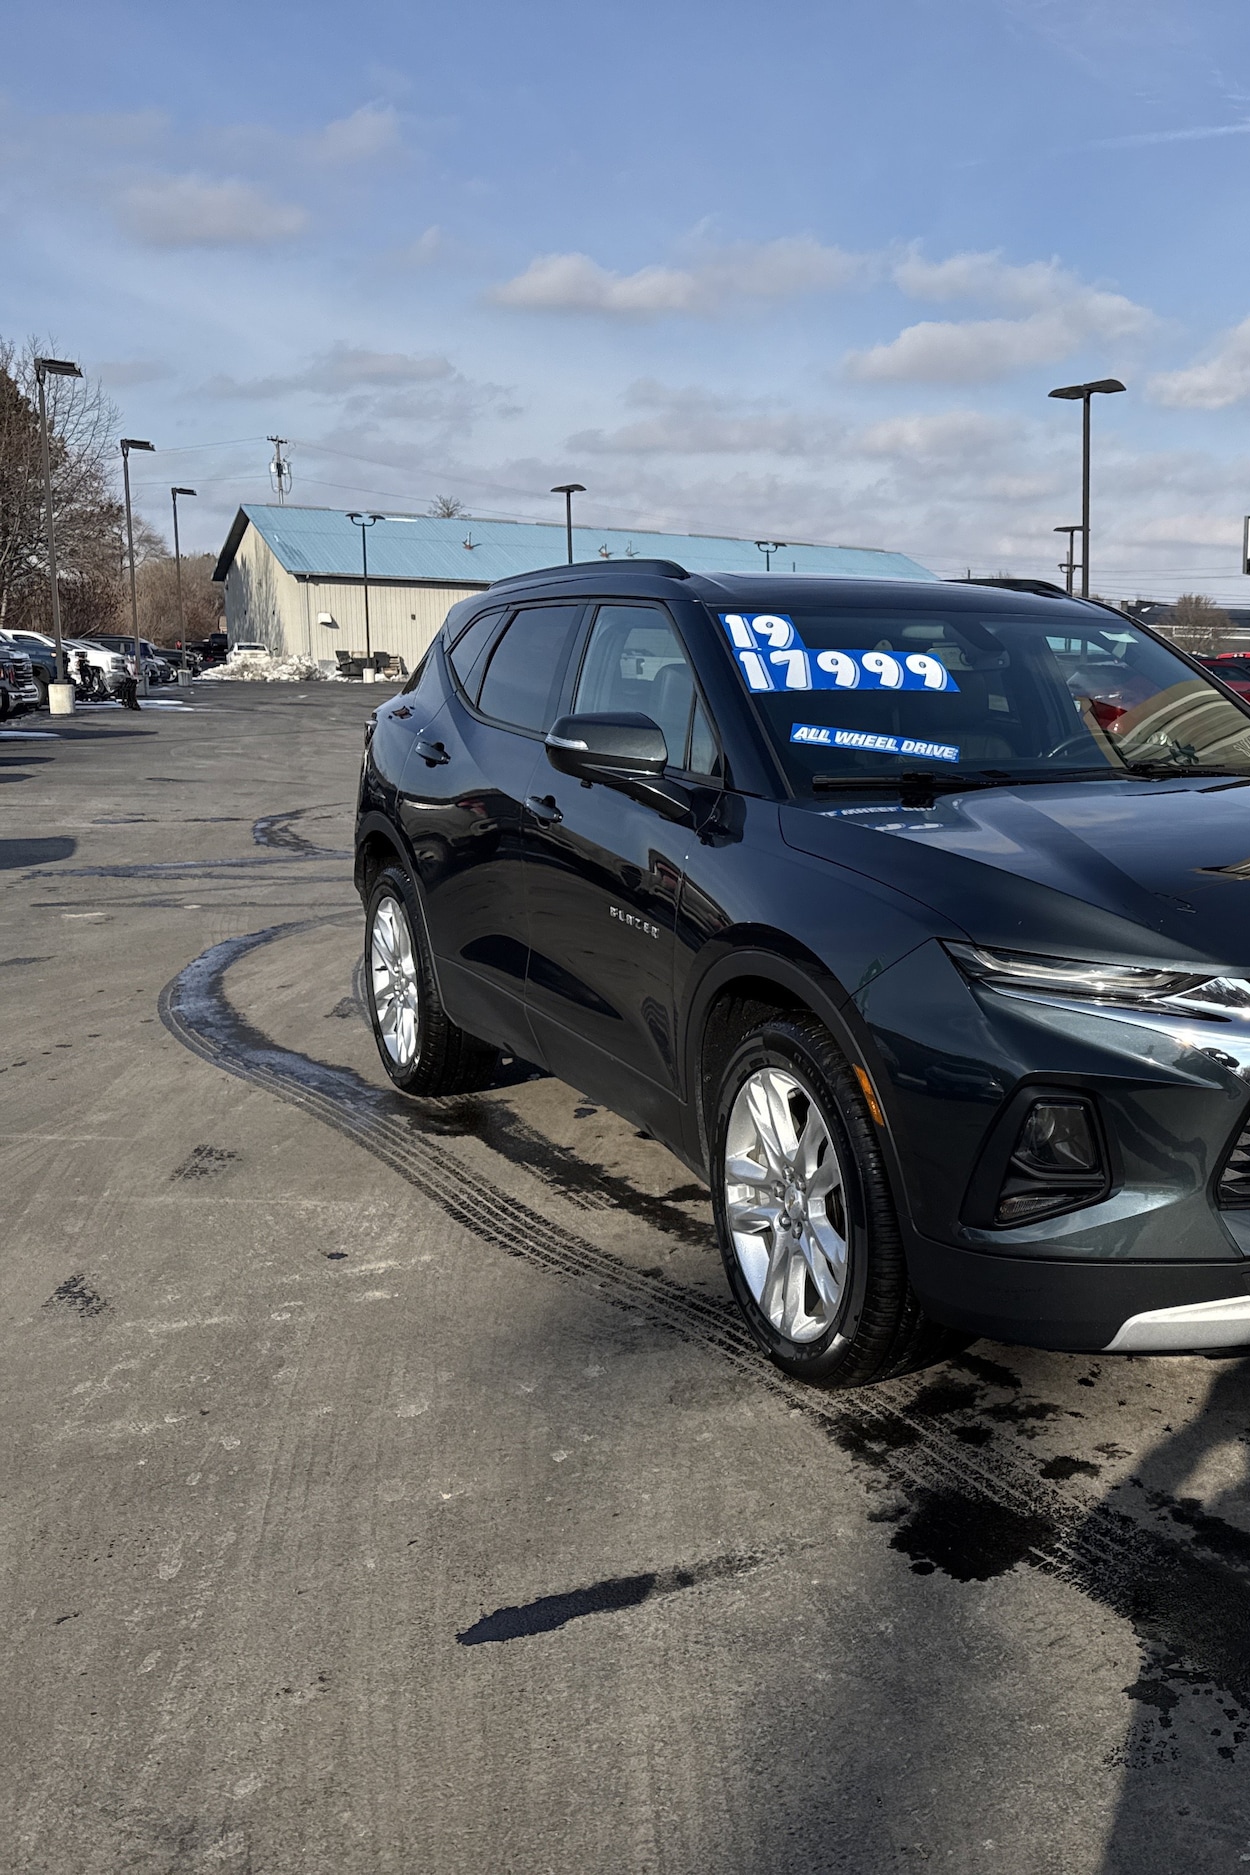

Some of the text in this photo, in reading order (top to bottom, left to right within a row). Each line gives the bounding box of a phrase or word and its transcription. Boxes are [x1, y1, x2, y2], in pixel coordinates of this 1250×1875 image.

[724, 614, 794, 649] 19
[739, 649, 948, 691] 17999
[793, 726, 958, 761] ALL WHEEL DRIVE
[609, 906, 659, 938] BLAZER
